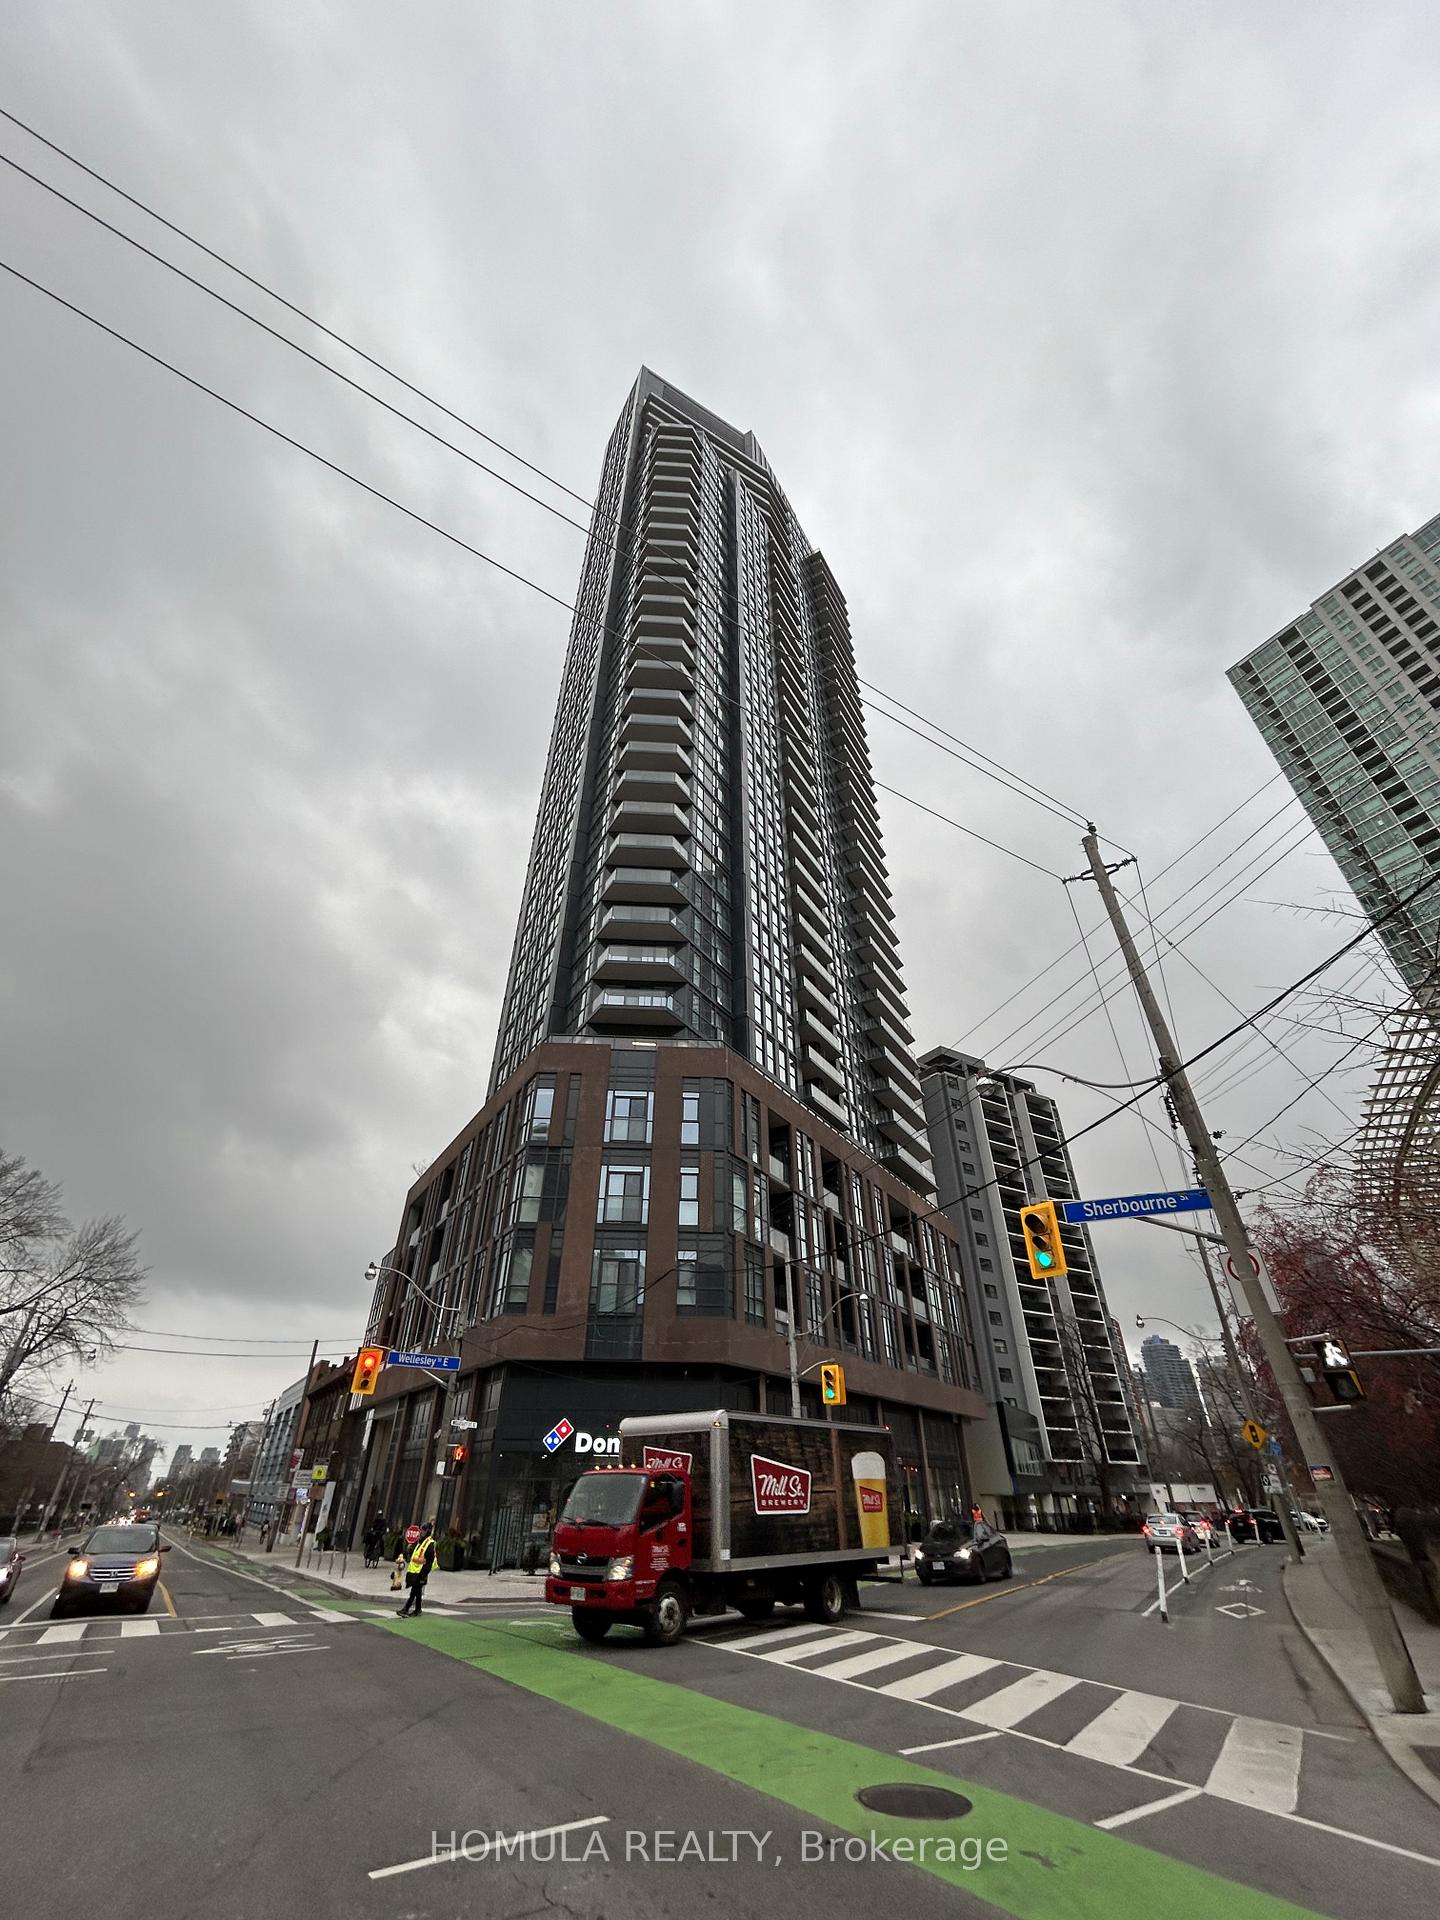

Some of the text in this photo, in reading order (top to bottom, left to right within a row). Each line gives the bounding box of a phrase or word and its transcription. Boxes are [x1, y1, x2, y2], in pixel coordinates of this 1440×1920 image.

[1083, 1197, 1177, 1217] Sherbourne
[398, 1353, 437, 1368] Wellesley
[443, 1357, 450, 1367] E
[758, 1474, 788, 1497] Mill
